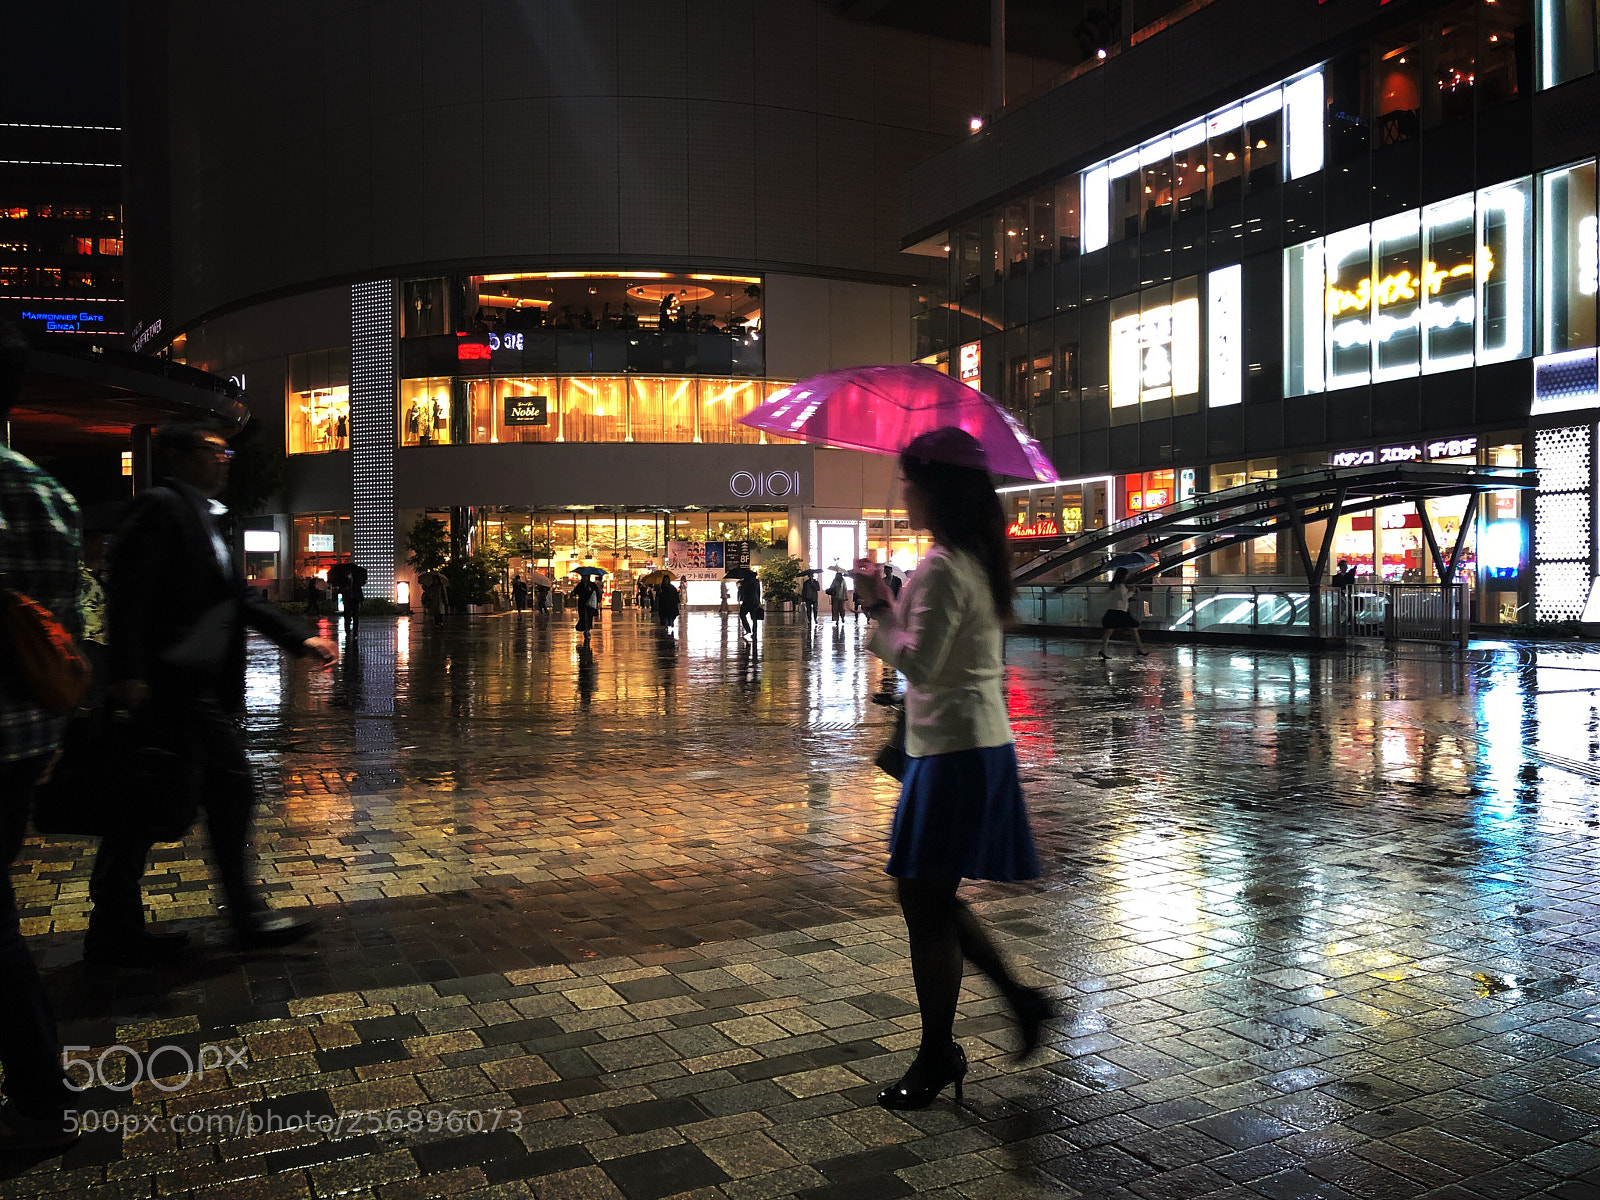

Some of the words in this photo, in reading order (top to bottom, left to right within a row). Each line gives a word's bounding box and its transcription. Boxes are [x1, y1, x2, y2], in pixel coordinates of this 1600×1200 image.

[22, 311, 78, 321] MARRONNIER
[79, 312, 104, 322] GATE
[46, 321, 75, 330] GINZA
[511, 407, 540, 417] Noble
[1333, 451, 1375, 466] パチンコ
[1380, 445, 1421, 462] スロット
[1009, 523, 1036, 536] Miami
[1038, 521, 1057, 535] Villa
[676, 572, 718, 580] シフト原画展
